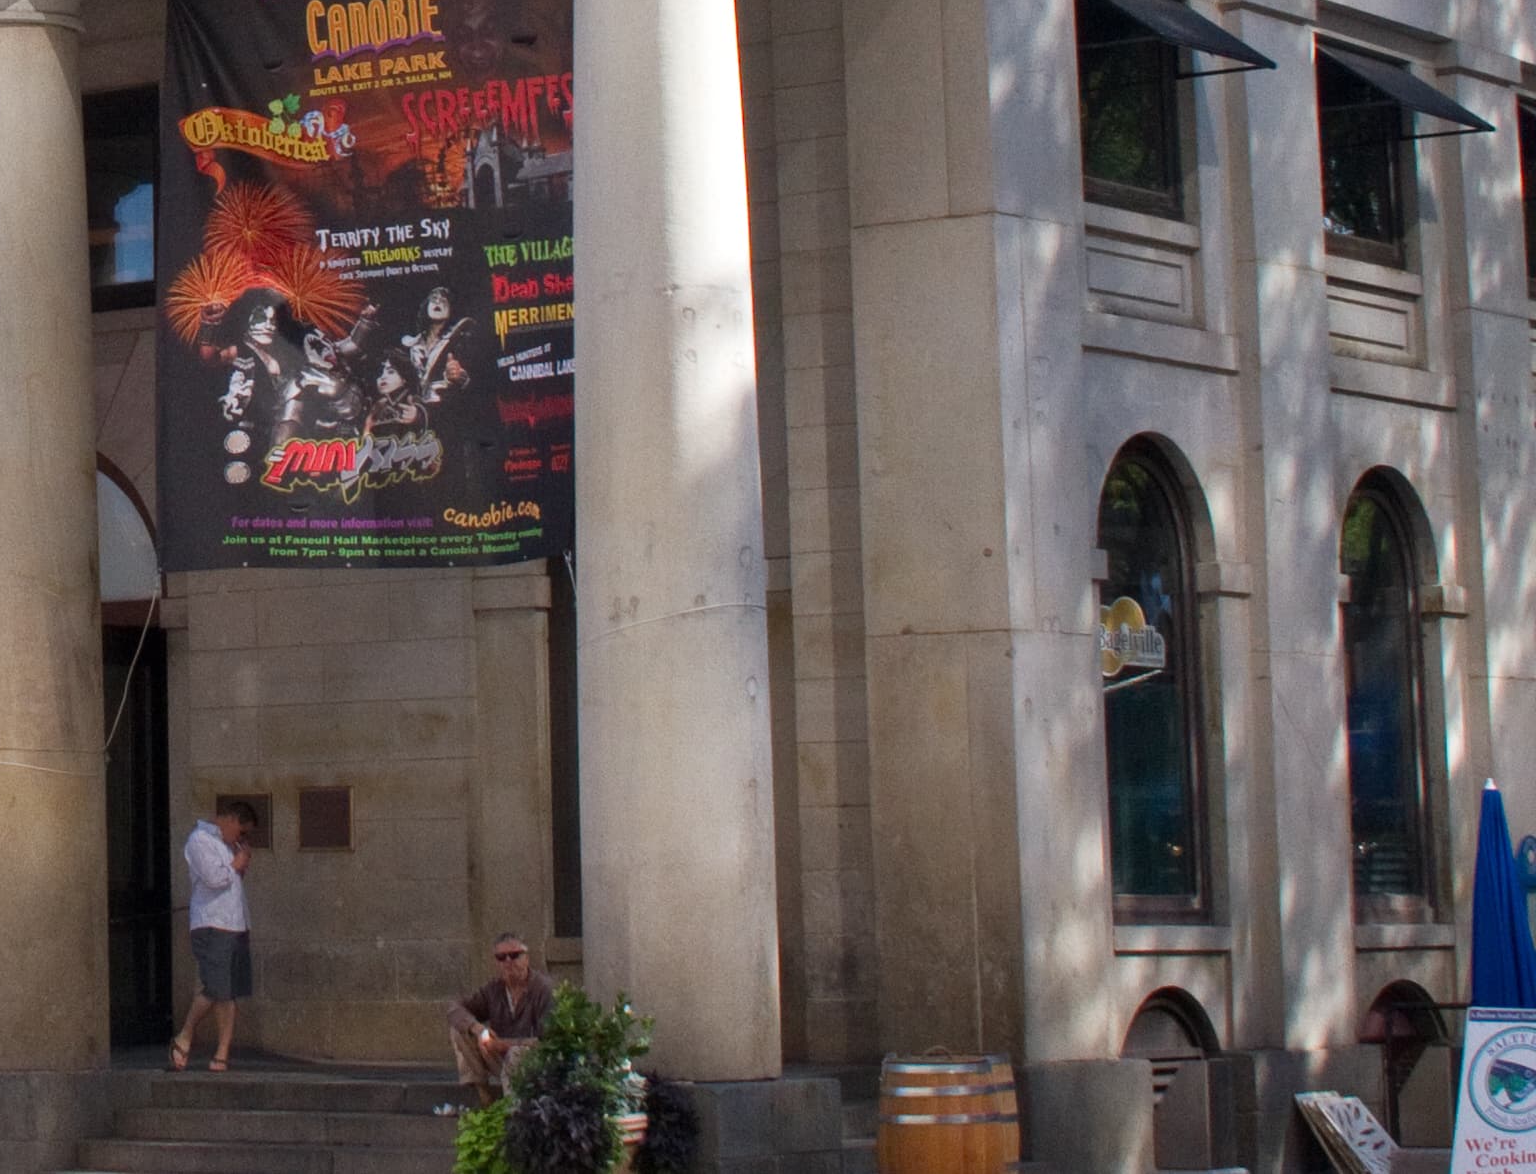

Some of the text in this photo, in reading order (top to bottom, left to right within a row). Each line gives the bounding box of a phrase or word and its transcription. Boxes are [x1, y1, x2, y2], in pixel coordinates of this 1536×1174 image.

[313, 51, 447, 85] LAKE PARK
[309, 87, 337, 97] ROUTE
[353, 82, 372, 92] EXIT
[381, 80, 394, 89] OR
[184, 109, 330, 163] Oktoberfest
[385, 224, 414, 244] THE
[420, 218, 451, 239] SKY
[482, 235, 574, 267] THE VILLAG
[509, 361, 554, 381] CANNIBAL
[230, 516, 249, 528] For
[287, 517, 307, 528] and
[309, 519, 338, 528] more
[340, 517, 404, 528] information
[443, 501, 541, 527] canobie.com
[222, 535, 247, 545] Join
[250, 536, 265, 544] us
[268, 535, 281, 544] at
[285, 535, 330, 545] Faneuil
[333, 535, 358, 545] Hall
[361, 535, 437, 547] Marketplace
[440, 534, 473, 545] every
[269, 547, 298, 556] from
[302, 547, 328, 558] 7pm
[338, 547, 364, 558] 9pm
[368, 547, 381, 557] to
[384, 546, 415, 556] meet
[419, 548, 427, 556] a
[430, 545, 479, 555] Canobie
[1099, 624, 1162, 657] Bagelville
[1486, 1033, 1528, 1057] SALTY
[1465, 1137, 1517, 1152] We're
